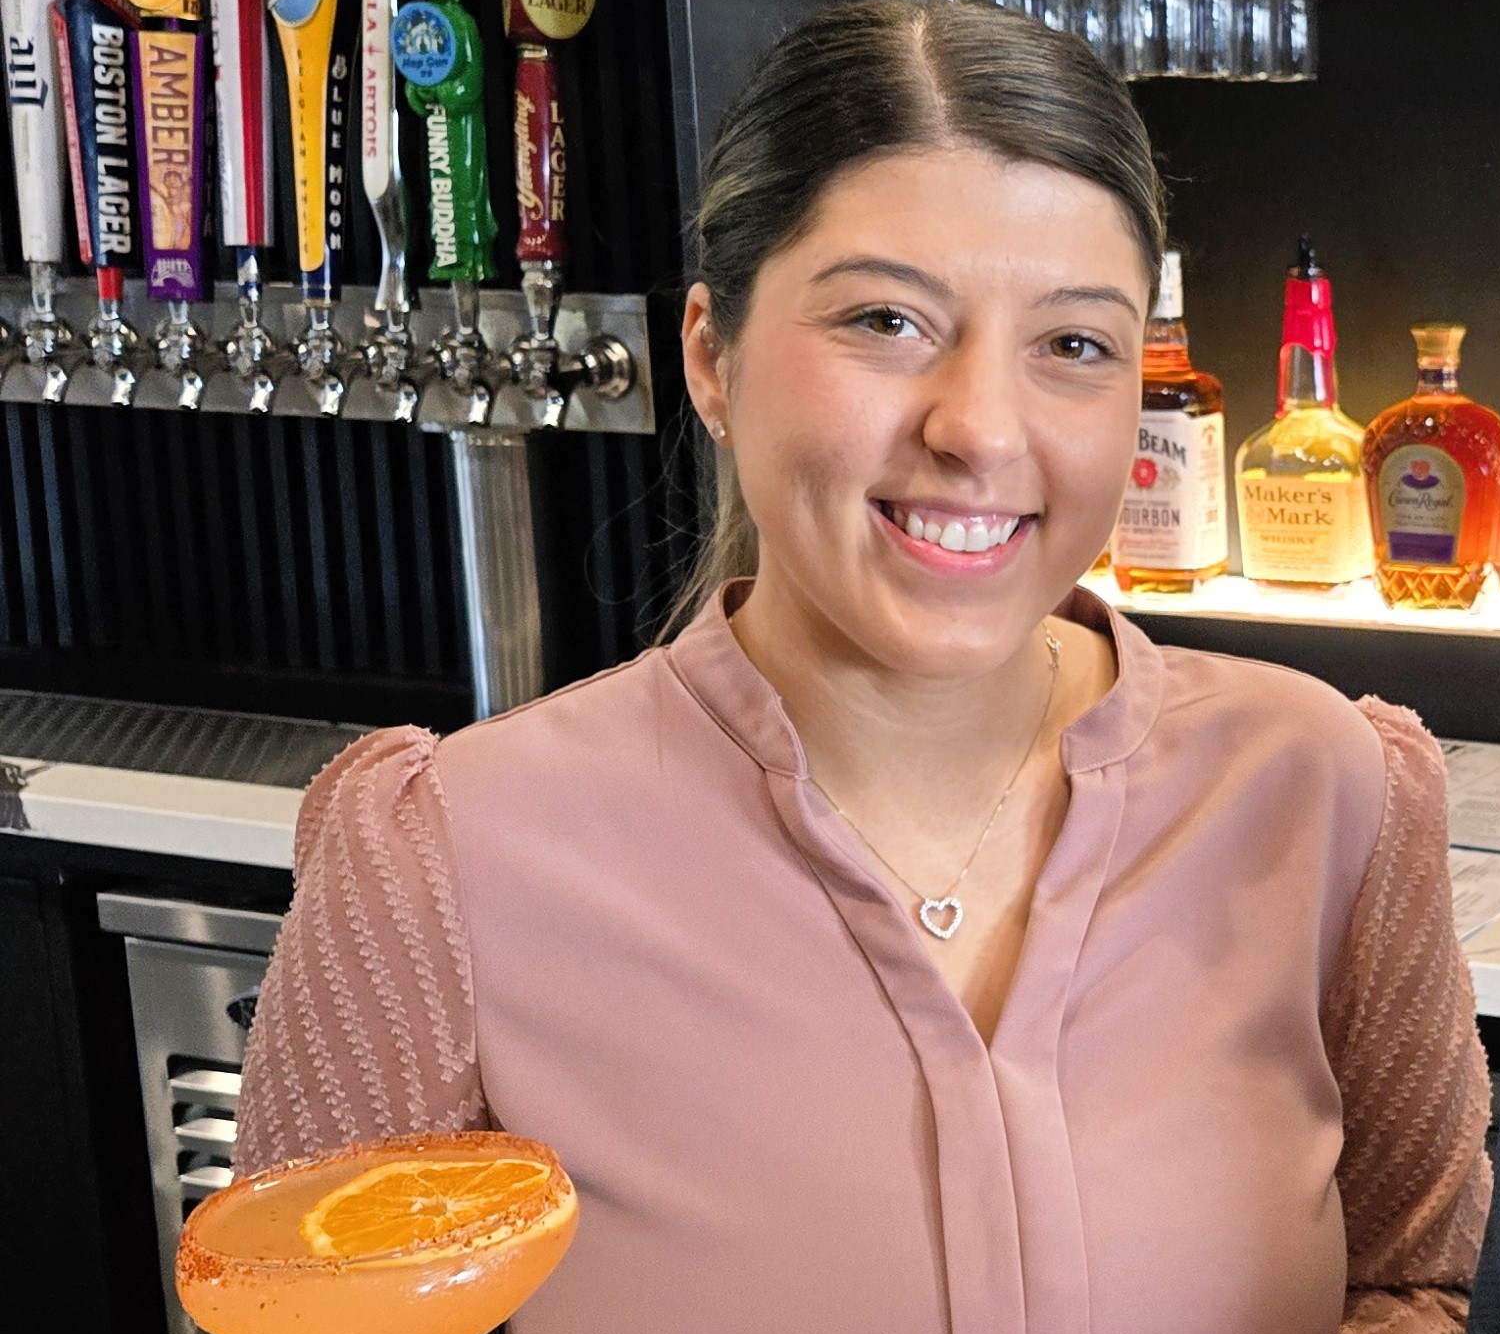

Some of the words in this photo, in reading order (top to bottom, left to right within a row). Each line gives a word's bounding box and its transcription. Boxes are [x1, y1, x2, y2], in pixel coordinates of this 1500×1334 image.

[9, 36, 49, 110] Lite
[91, 22, 128, 146] BOSTON
[149, 44, 191, 167] AMBER
[366, 70, 378, 159] ARTOIS
[424, 103, 451, 176] FUNKY
[549, 100, 567, 222] LAGER
[97, 154, 132, 255] LAGER
[328, 164, 343, 251] MOON
[429, 176, 458, 269] BUDDHA
[1138, 427, 1188, 467] BEAM
[1118, 508, 1182, 527] OURBON
[1244, 485, 1333, 504] Maker's
[1266, 507, 1332, 525] Mark
[1260, 534, 1318, 545] WHISKY
